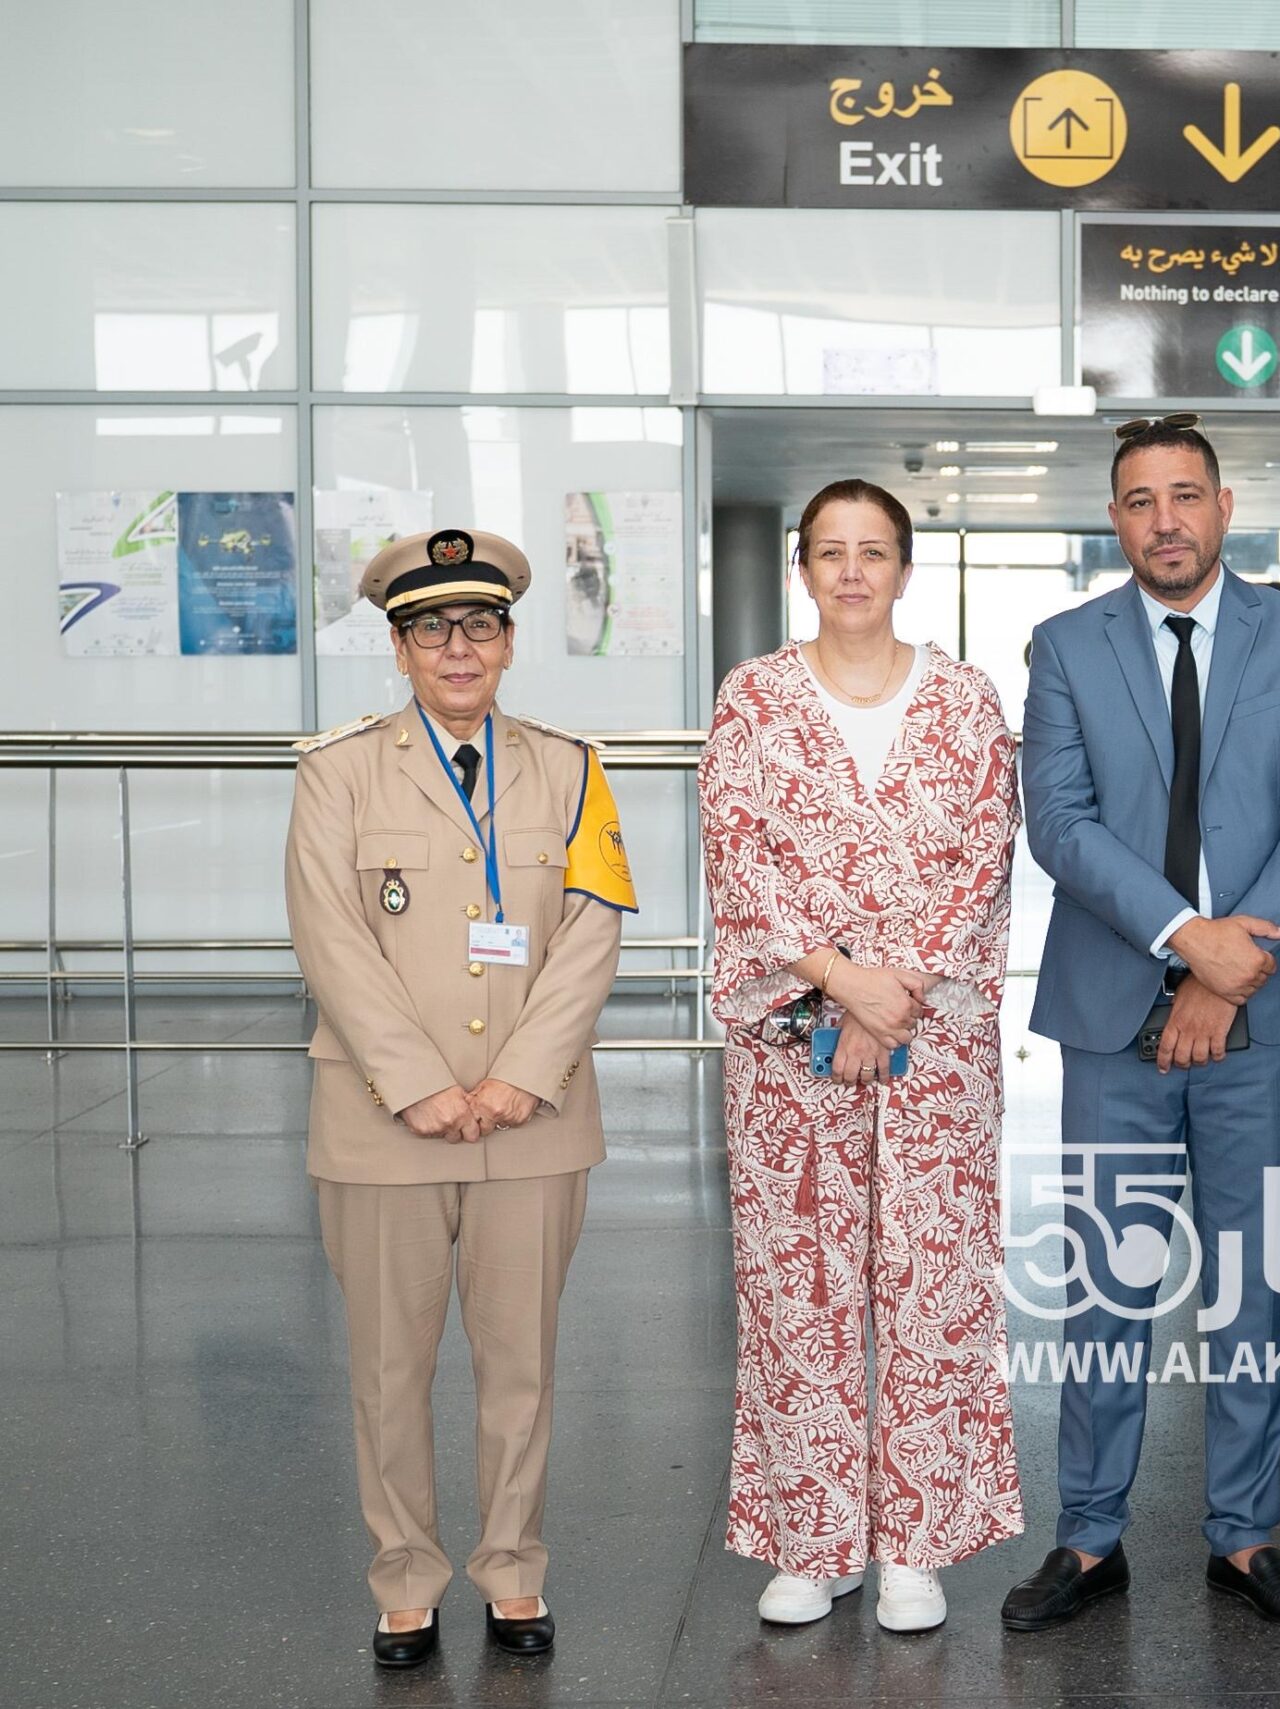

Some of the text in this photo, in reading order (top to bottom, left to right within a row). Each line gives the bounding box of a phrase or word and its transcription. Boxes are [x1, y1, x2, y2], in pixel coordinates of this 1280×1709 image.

[829, 67, 954, 126] خروج
[840, 141, 943, 187] Exit
[1120, 241, 1278, 275] لا شيء يصرح به
[1120, 284, 1279, 305] Nothing to declare
